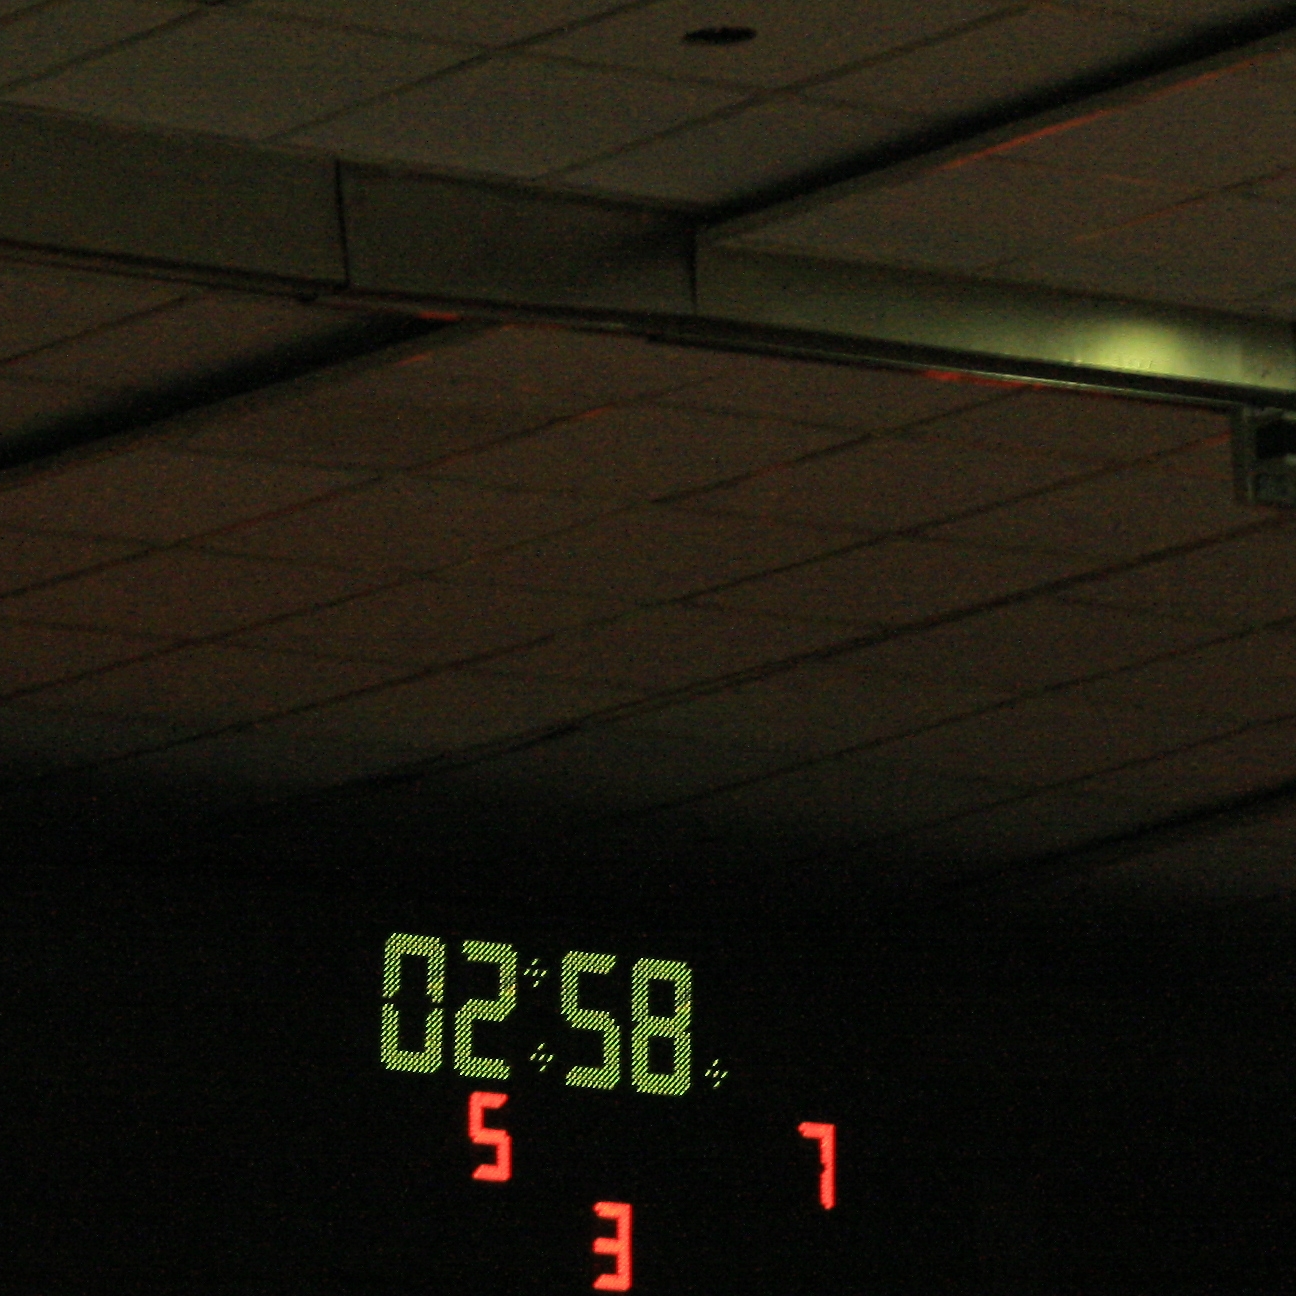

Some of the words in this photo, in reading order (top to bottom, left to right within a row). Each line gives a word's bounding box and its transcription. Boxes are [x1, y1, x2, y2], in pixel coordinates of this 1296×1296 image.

[467, 1091, 513, 1183] 5
[797, 1121, 836, 1210] 7
[592, 1201, 633, 1292] 3
